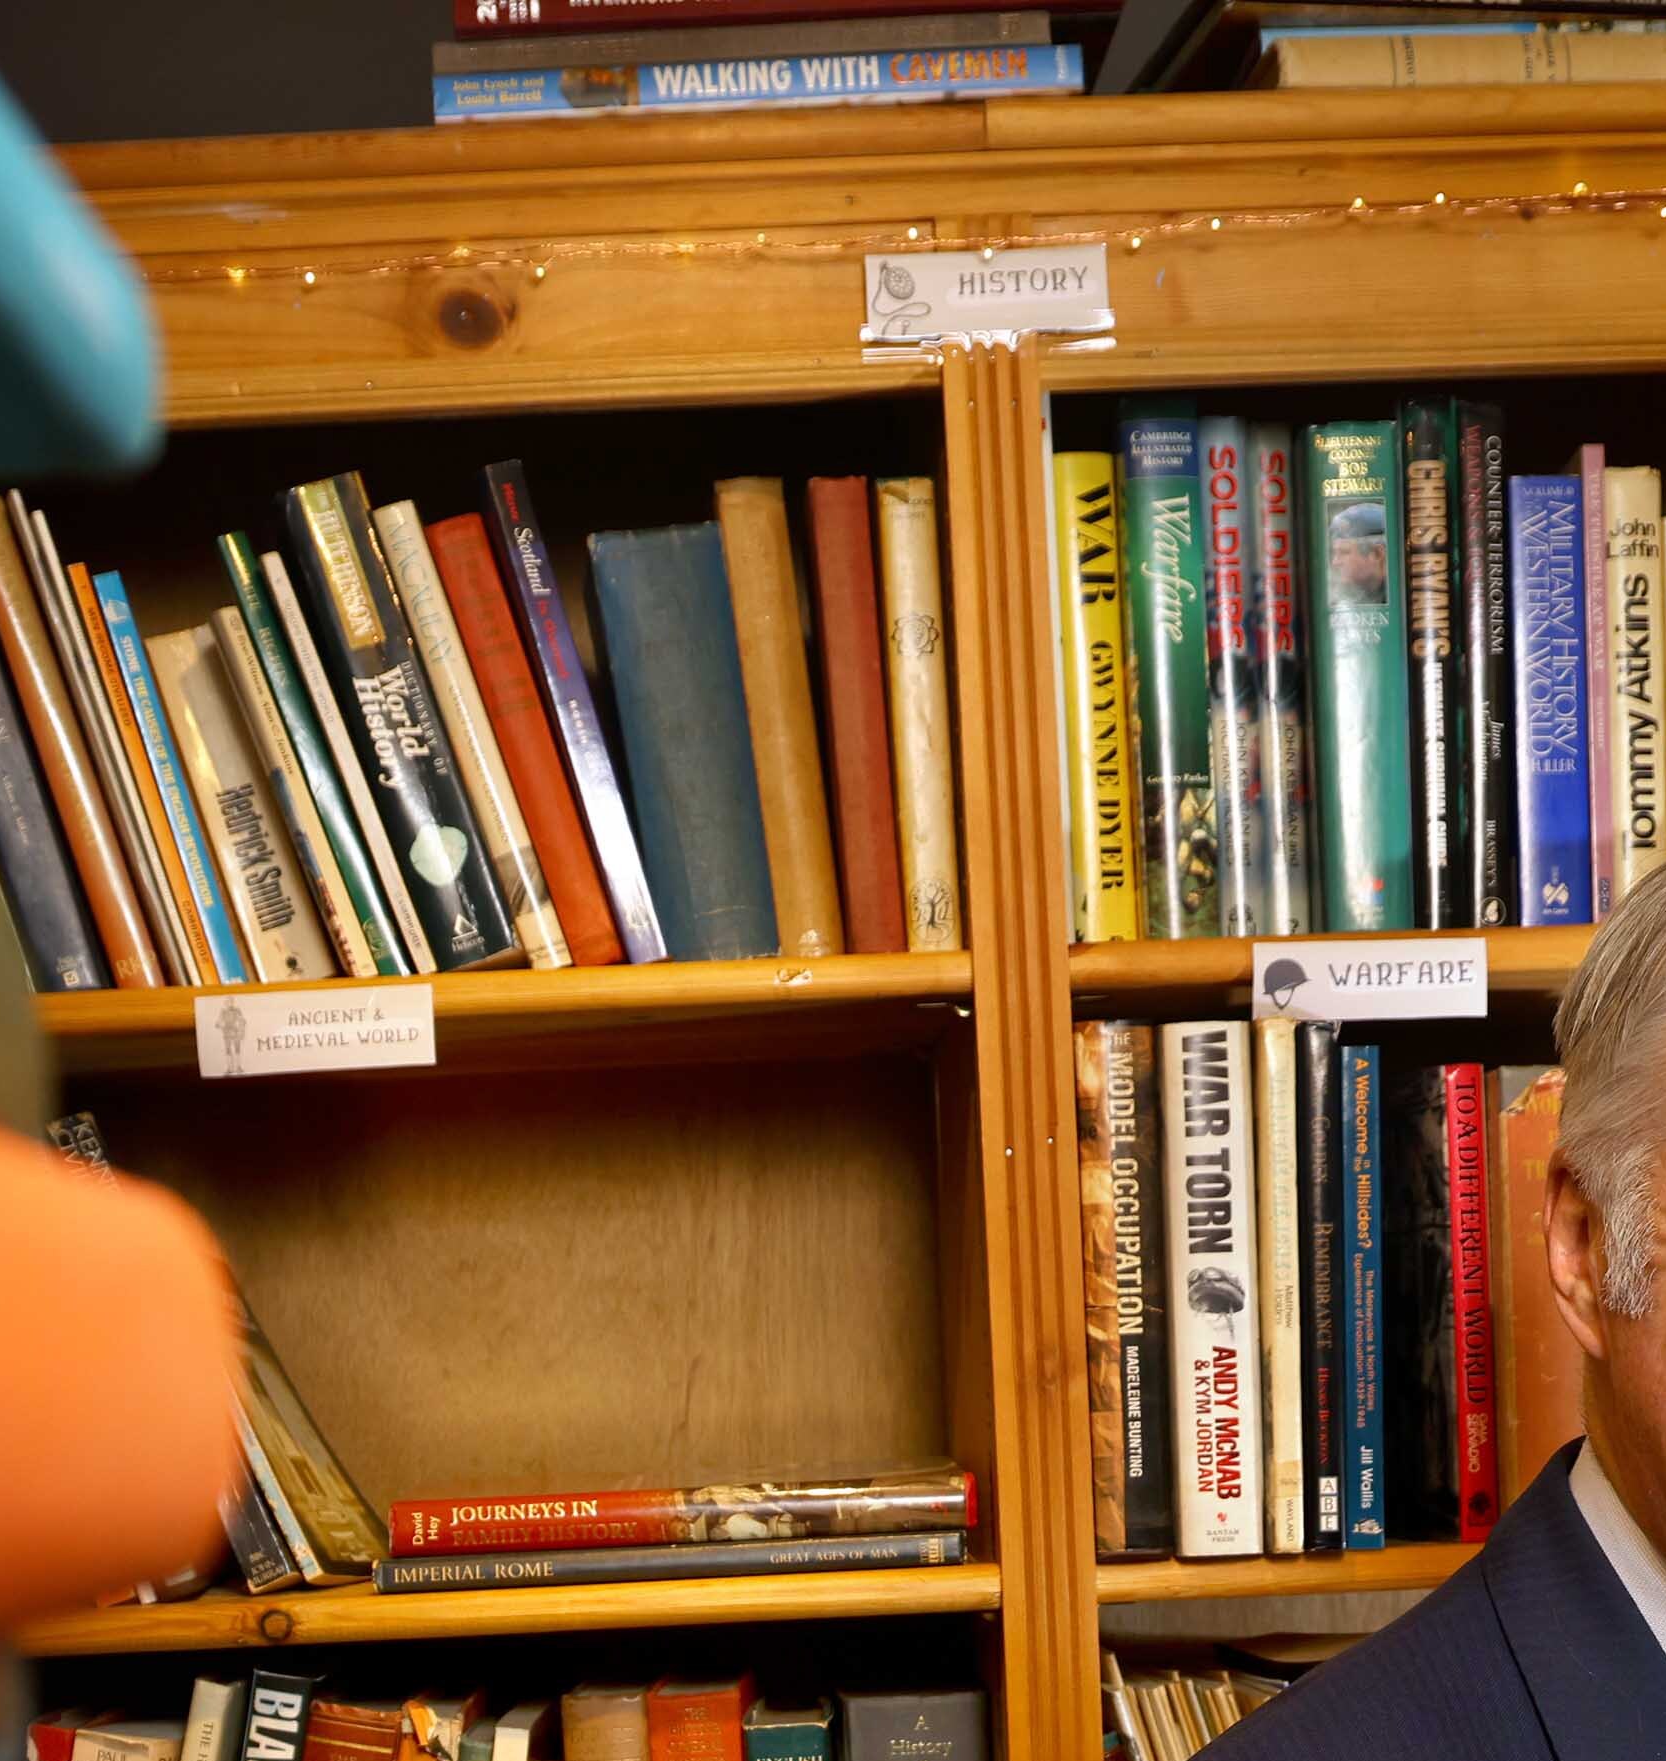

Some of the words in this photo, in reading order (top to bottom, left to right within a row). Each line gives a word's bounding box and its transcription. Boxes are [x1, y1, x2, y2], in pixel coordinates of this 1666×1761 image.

[654, 60, 791, 97] WALKING
[801, 53, 879, 90] WITH
[890, 48, 1028, 84] CAVEMEN
[957, 267, 1090, 296] HISTORY
[1076, 484, 1116, 606] WAR
[1208, 447, 1245, 651] SOLDIERS
[1407, 460, 1447, 549] CHRIS
[1606, 539, 1660, 559] Laffin
[1610, 518, 1656, 539] John
[1141, 492, 1196, 644] Warfare
[1259, 449, 1293, 653] SOLDIERS
[1518, 509, 1552, 650] WESTERN
[1547, 499, 1575, 635] MILITARY
[1410, 554, 1451, 657] RYAN'S
[1615, 573, 1655, 705] Atkins
[1090, 640, 1121, 788] GWYNNE
[1523, 647, 1552, 757] WORLD
[1550, 637, 1580, 757] HISTORY
[1621, 709, 1659, 858] Tommy
[217, 783, 272, 868] Hedrick
[247, 859, 296, 930] Smith
[1098, 798, 1124, 890] DYER
[288, 1008, 368, 1028] ANCIENT
[374, 1008, 386, 1023] &
[1328, 960, 1476, 988] WARFARE
[256, 1030, 348, 1053] MEDIEVAL
[356, 1026, 421, 1045] WORLD
[1181, 1028, 1229, 1138] WAR
[1355, 1057, 1368, 1071] A
[1108, 1051, 1135, 1153] MODEL
[1354, 1075, 1369, 1155] Welcome
[1455, 1076, 1477, 1115] TO
[1110, 1156, 1144, 1338] OCCUPATION
[1184, 1149, 1233, 1256] TORN
[1356, 1174, 1373, 1249] Hillsides?
[1459, 1144, 1484, 1301] DIFFERENT
[1126, 1345, 1141, 1420] MADELEINE
[1194, 1359, 1210, 1373] &
[1194, 1375, 1211, 1412] KYM
[1212, 1345, 1239, 1412] ANDY
[1465, 1304, 1487, 1405] WORLD
[1129, 1421, 1144, 1479] BUNTING
[1196, 1416, 1213, 1493] JORDAN
[1213, 1415, 1242, 1500] MCNAB
[450, 1500, 566, 1525] JOURNEYS
[571, 1498, 597, 1519] IN
[392, 1561, 486, 1584] IMPERIAL
[495, 1559, 556, 1581] ROME
